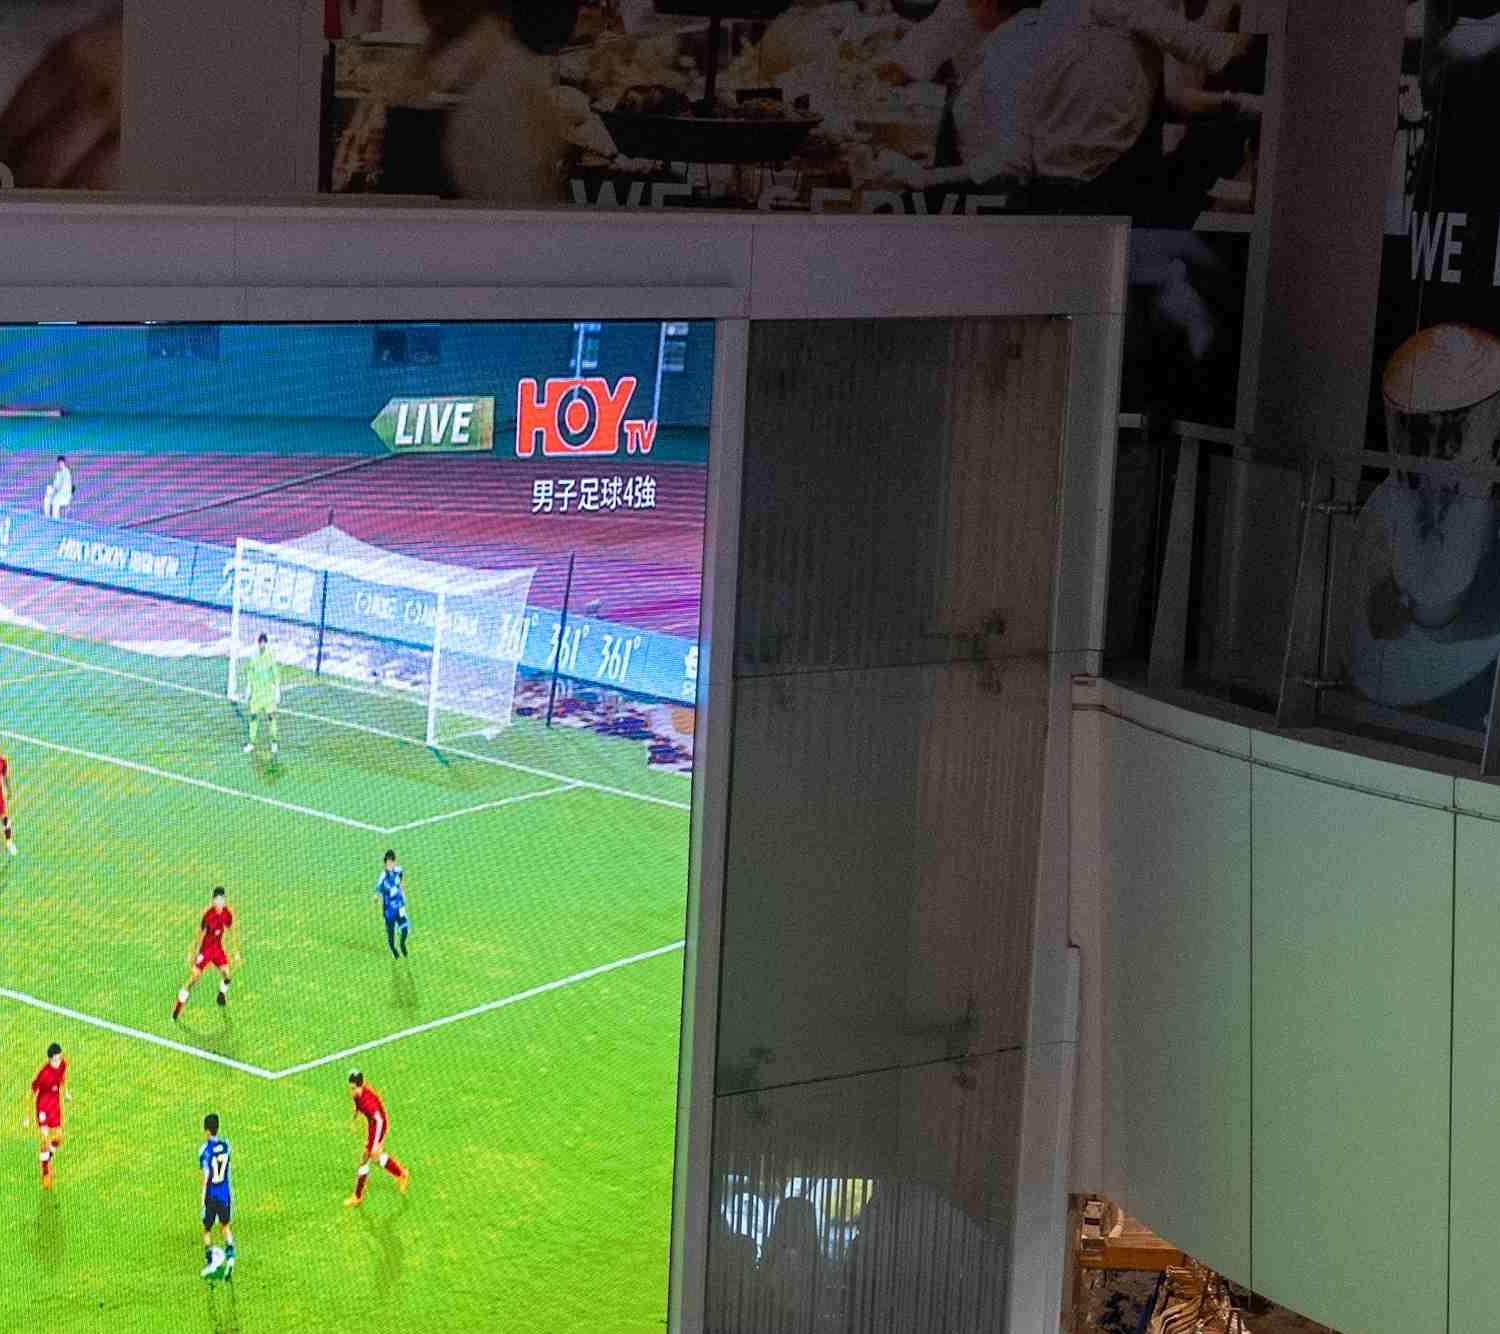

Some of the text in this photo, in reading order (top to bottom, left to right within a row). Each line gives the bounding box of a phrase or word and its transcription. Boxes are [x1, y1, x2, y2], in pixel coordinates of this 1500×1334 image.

[1409, 209, 1465, 285] WE
[394, 402, 475, 446] LIVE
[516, 377, 638, 458] HOY
[531, 475, 657, 513] 男子足球4強
[596, 632, 644, 682] 361°
